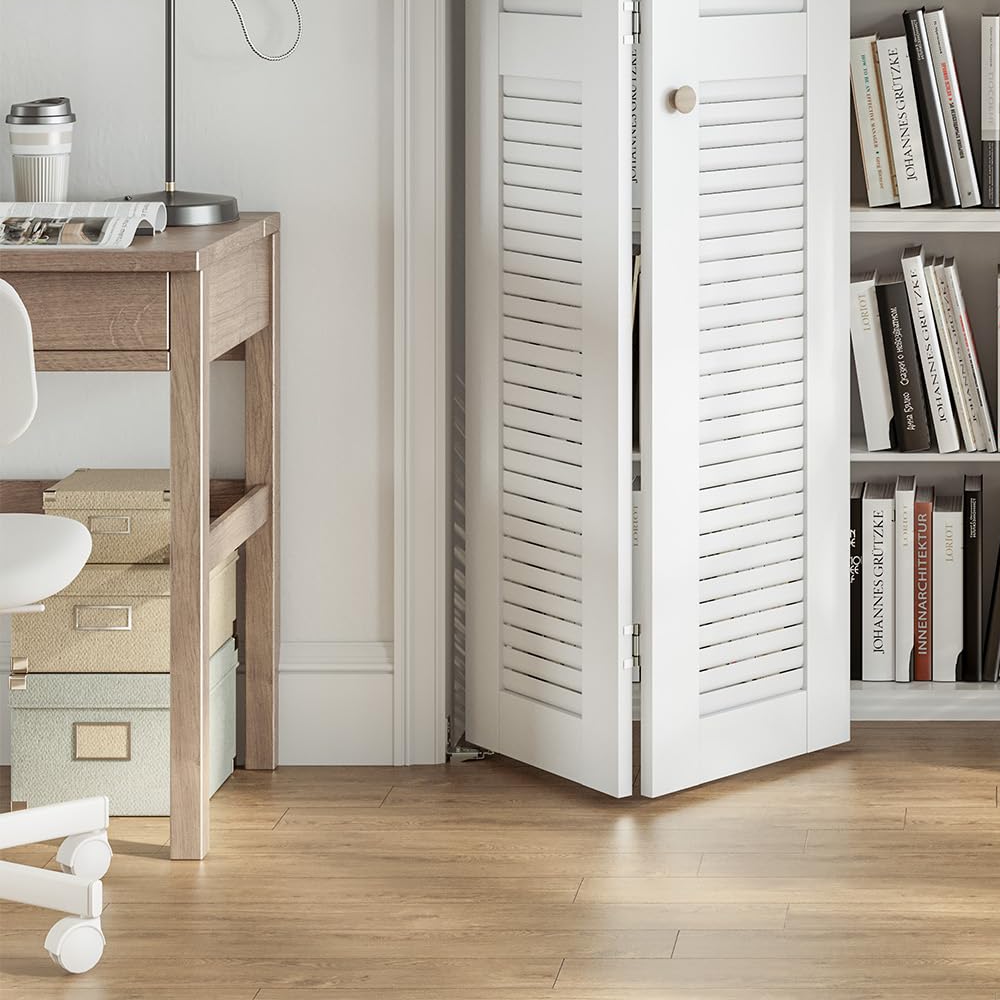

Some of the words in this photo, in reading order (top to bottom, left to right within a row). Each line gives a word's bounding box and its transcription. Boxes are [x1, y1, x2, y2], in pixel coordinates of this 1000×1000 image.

[888, 47, 905, 110] GRÜTZKE
[900, 111, 917, 181] JOHANNES
[857, 294, 871, 332] LORIOT
[899, 360, 909, 385] Сказки
[926, 344, 947, 423] JOHANNES
[906, 414, 916, 431] Анна
[871, 510, 884, 577] GRÜTZKE
[945, 523, 953, 562] LORIOT
[873, 580, 884, 654] JOHANNES
[918, 514, 928, 655] INNENARCHITEKTUR
